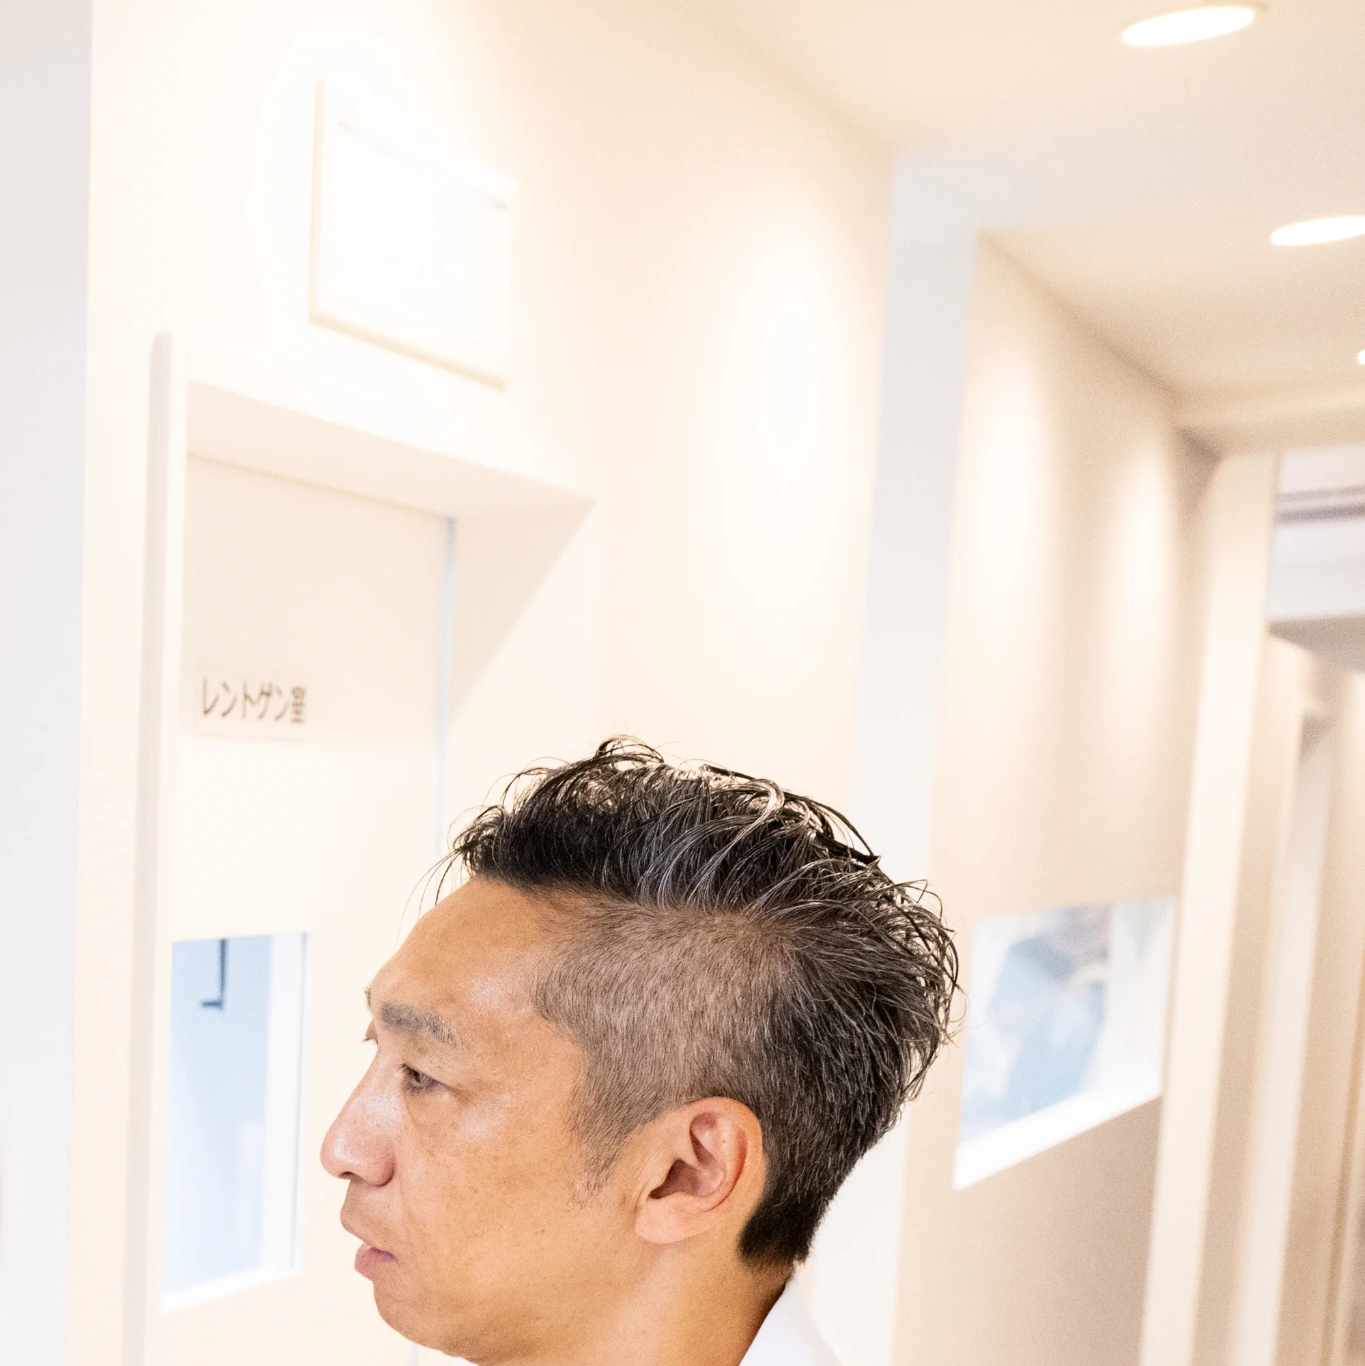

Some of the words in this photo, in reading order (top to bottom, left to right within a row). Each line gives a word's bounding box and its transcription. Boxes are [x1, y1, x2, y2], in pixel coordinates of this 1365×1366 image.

[202, 678, 306, 724] レントゲン室
